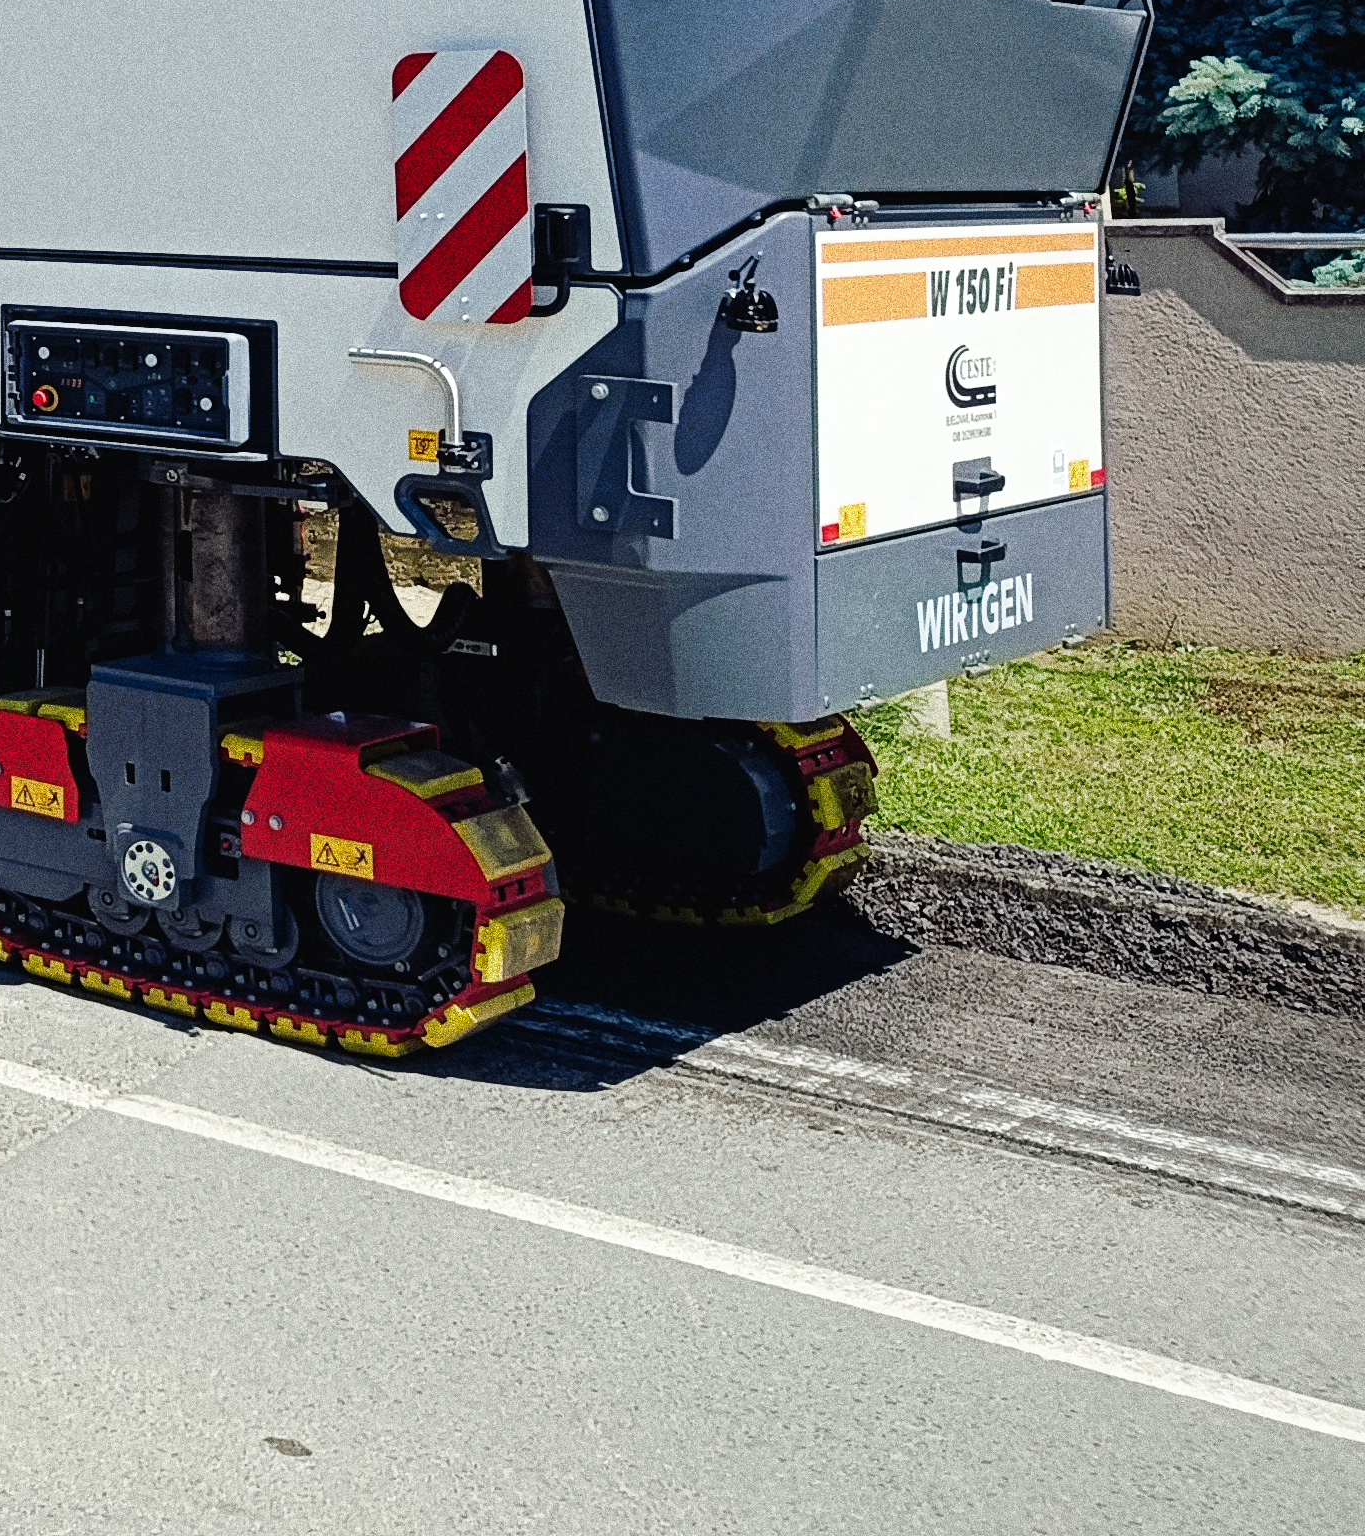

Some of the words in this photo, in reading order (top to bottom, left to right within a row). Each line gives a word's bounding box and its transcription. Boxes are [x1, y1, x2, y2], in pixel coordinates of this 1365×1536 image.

[931, 270, 950, 317] W
[956, 267, 990, 315] 150
[995, 261, 1013, 312] Fi
[959, 356, 992, 380] CESTE
[916, 572, 1034, 653] WIRTGEN
